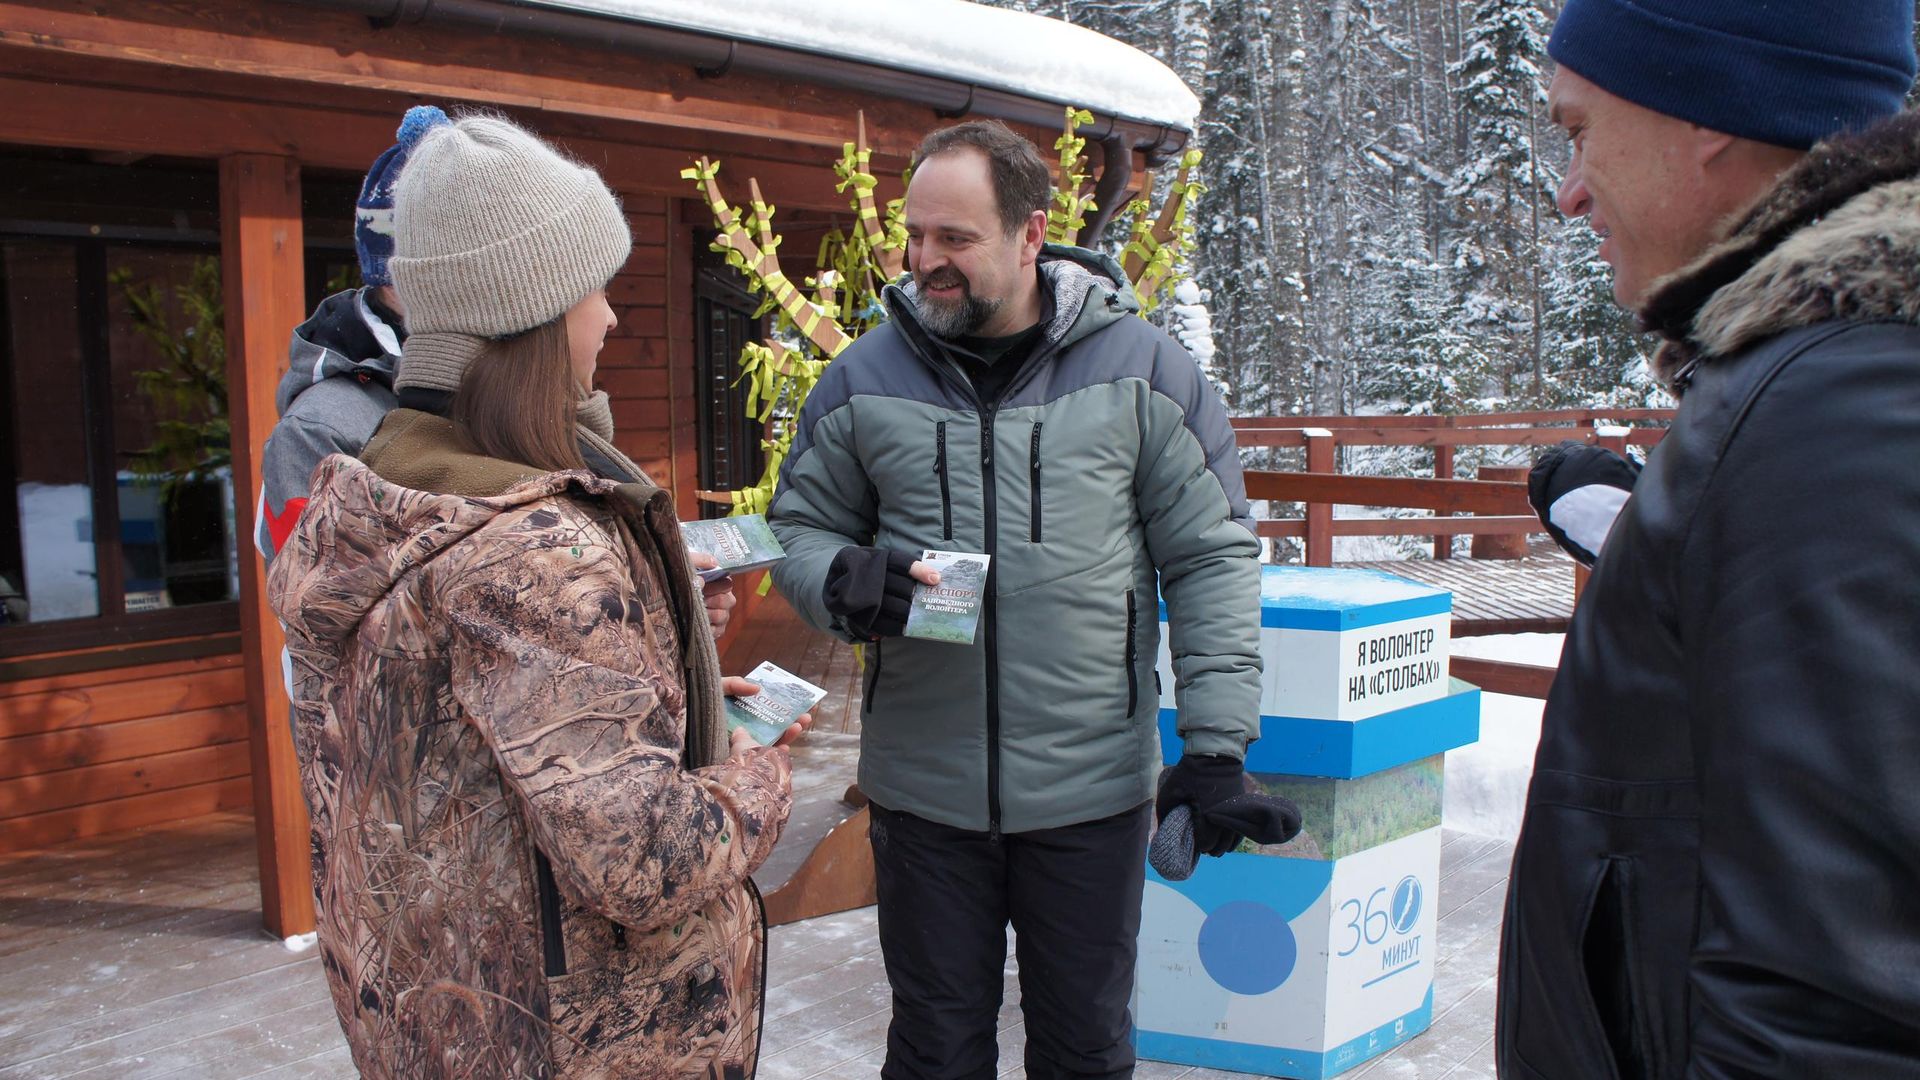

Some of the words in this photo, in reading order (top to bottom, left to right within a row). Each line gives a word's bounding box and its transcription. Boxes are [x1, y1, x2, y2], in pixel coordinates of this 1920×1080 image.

[921, 597, 974, 608] ЗАПОВЕДНОГО
[925, 587, 976, 598] ПАСПОРТ
[924, 604, 967, 614] ВОЛОНТЕРА
[1358, 641, 1366, 667] Я
[1370, 628, 1434, 664] ВОЛОНТЕР
[1348, 675, 1366, 702] НА
[1369, 660, 1440, 695] «СТОЛБАХ»
[1382, 935, 1421, 970] МИНУТ
